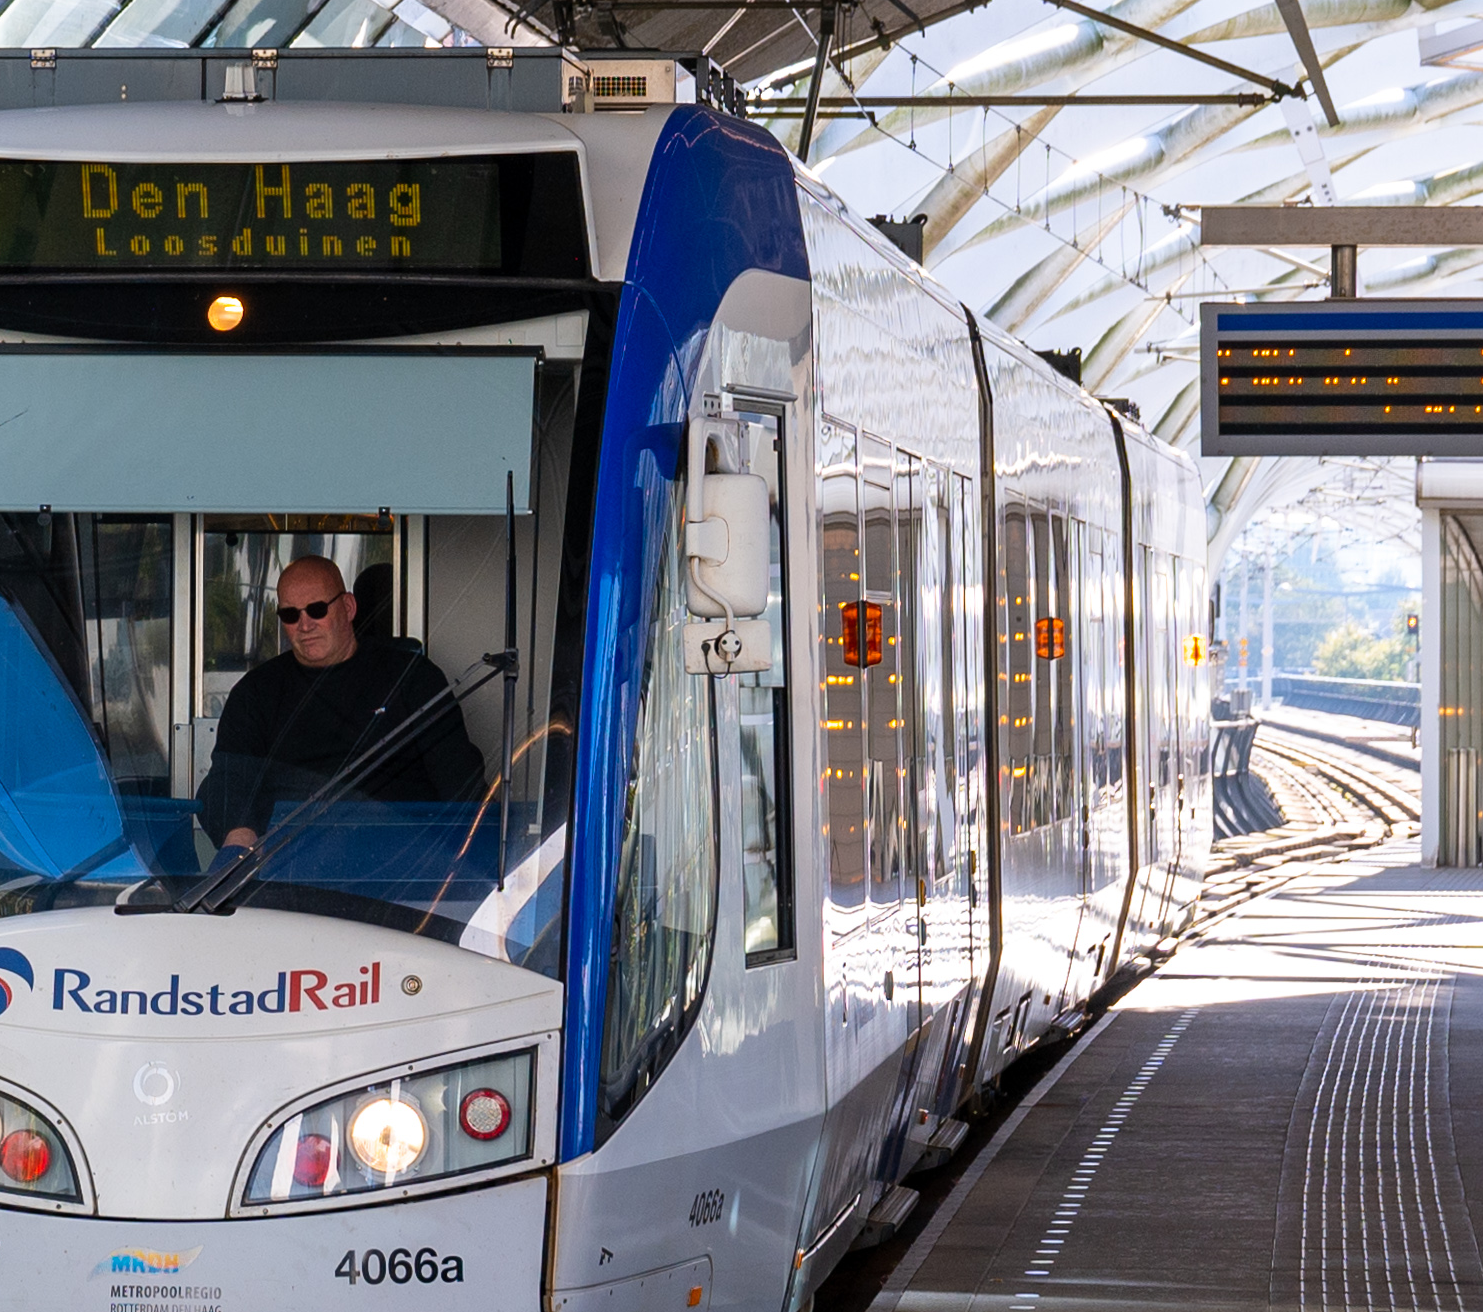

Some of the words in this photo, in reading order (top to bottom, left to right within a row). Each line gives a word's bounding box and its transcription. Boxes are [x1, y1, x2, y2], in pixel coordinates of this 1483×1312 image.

[81, 164, 208, 219] Den
[255, 164, 422, 227] Haag
[96, 227, 412, 258] Loosduinen
[52, 961, 381, 1016] RandstadRail
[133, 1110, 189, 1126] ALSTOM
[688, 1188, 725, 1228] 4066a
[334, 1247, 464, 1285] 4066a
[110, 1285, 222, 1300] METROPOOLREGIO
